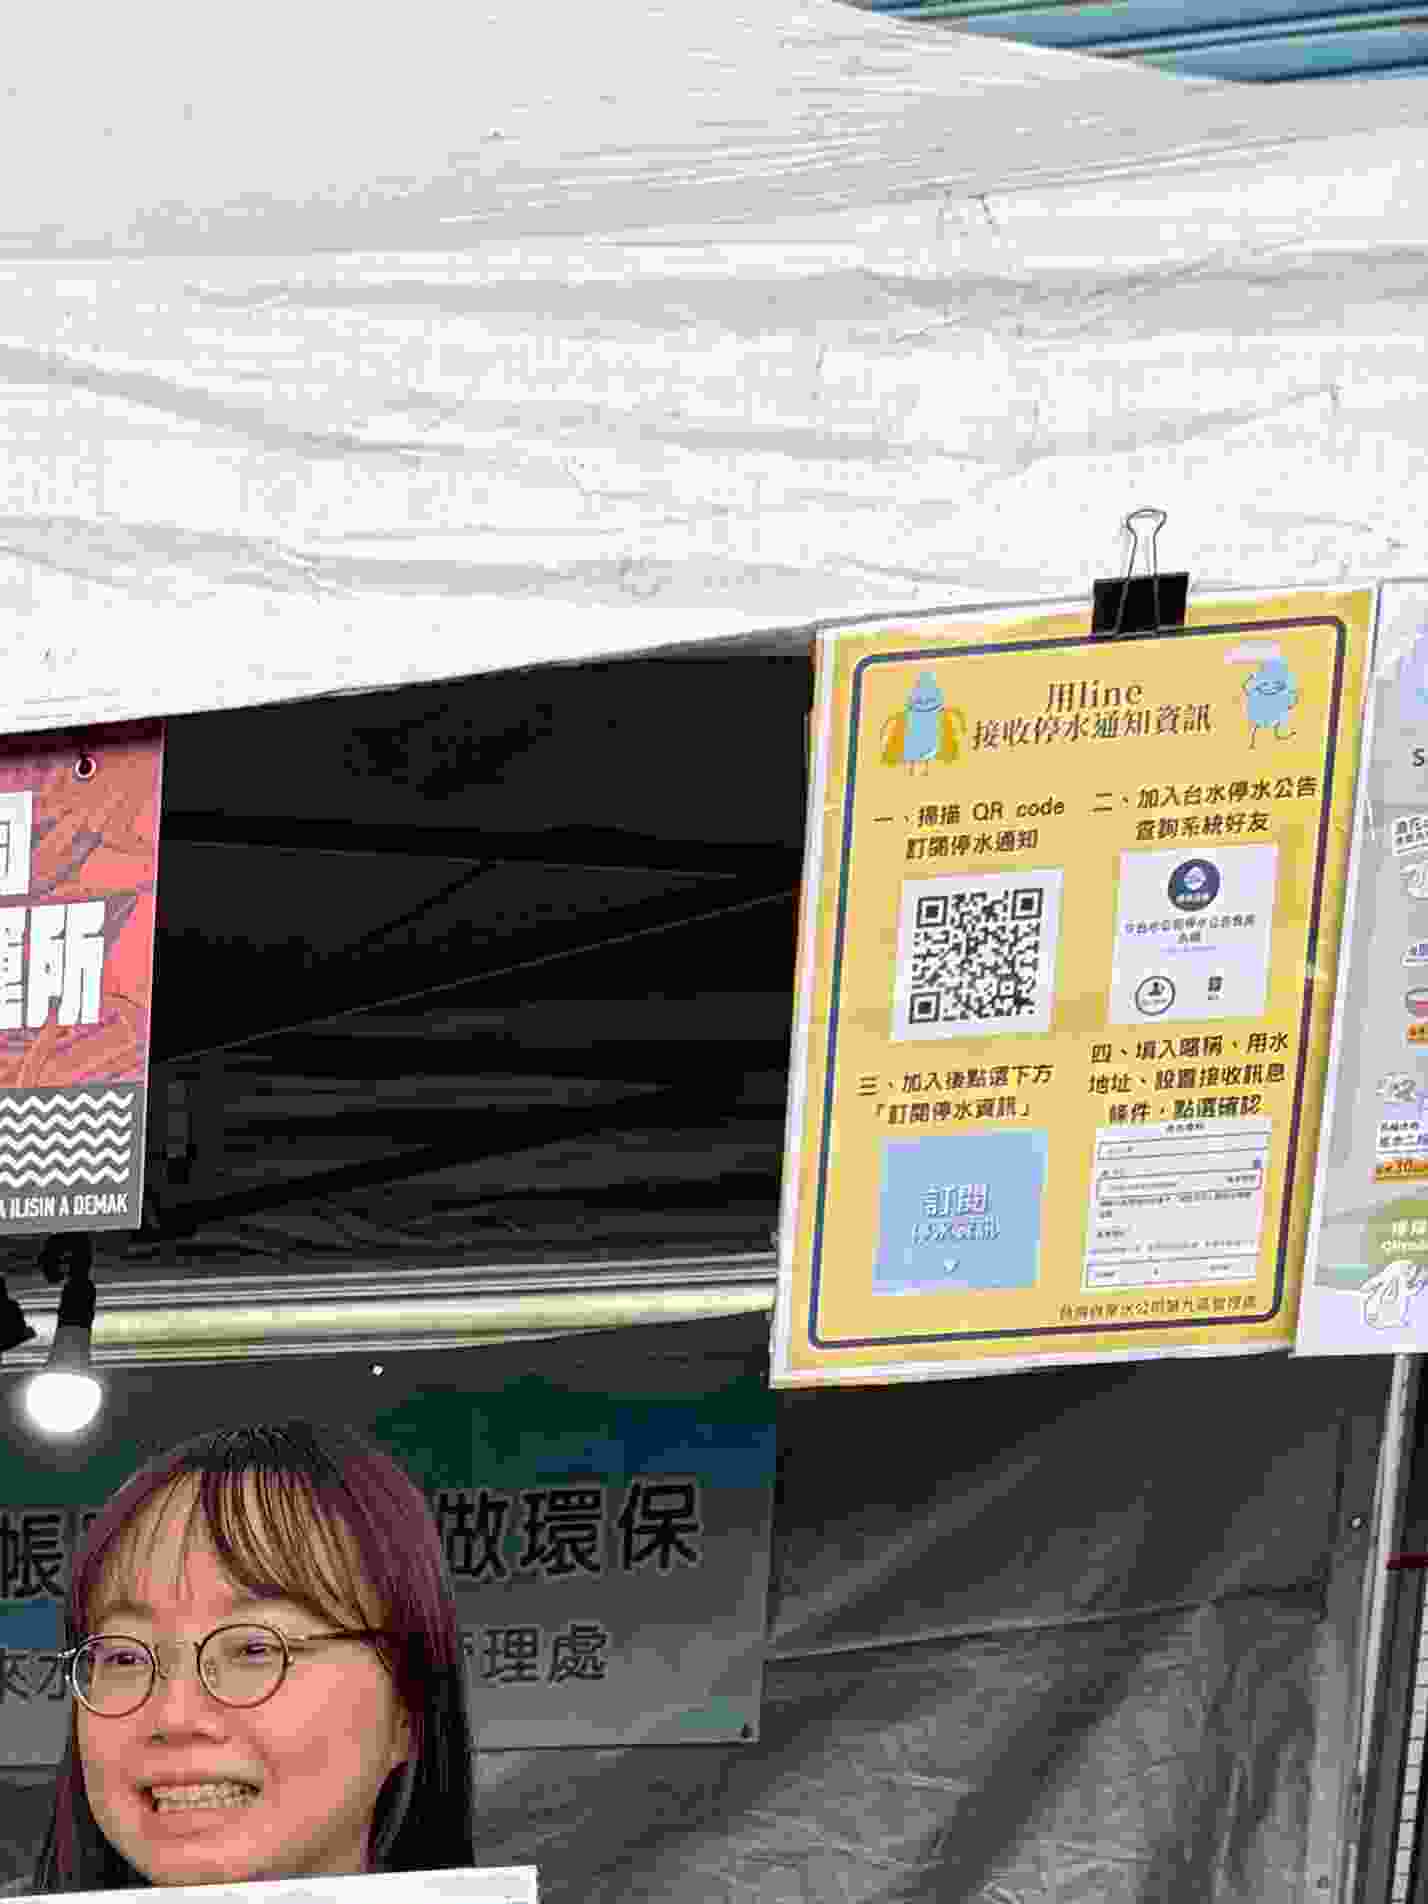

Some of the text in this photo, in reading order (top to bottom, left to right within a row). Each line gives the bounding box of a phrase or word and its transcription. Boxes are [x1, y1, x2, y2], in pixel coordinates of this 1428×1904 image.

[1047, 679, 1145, 713] 用line
[972, 704, 1214, 750] 接收停水通知資訊
[973, 800, 1003, 821] QR
[1016, 796, 1065, 817] code
[60, 1195, 70, 1216] A
[73, 1193, 129, 1216] DEMAK
[463, 1622, 609, 1687] 理處
